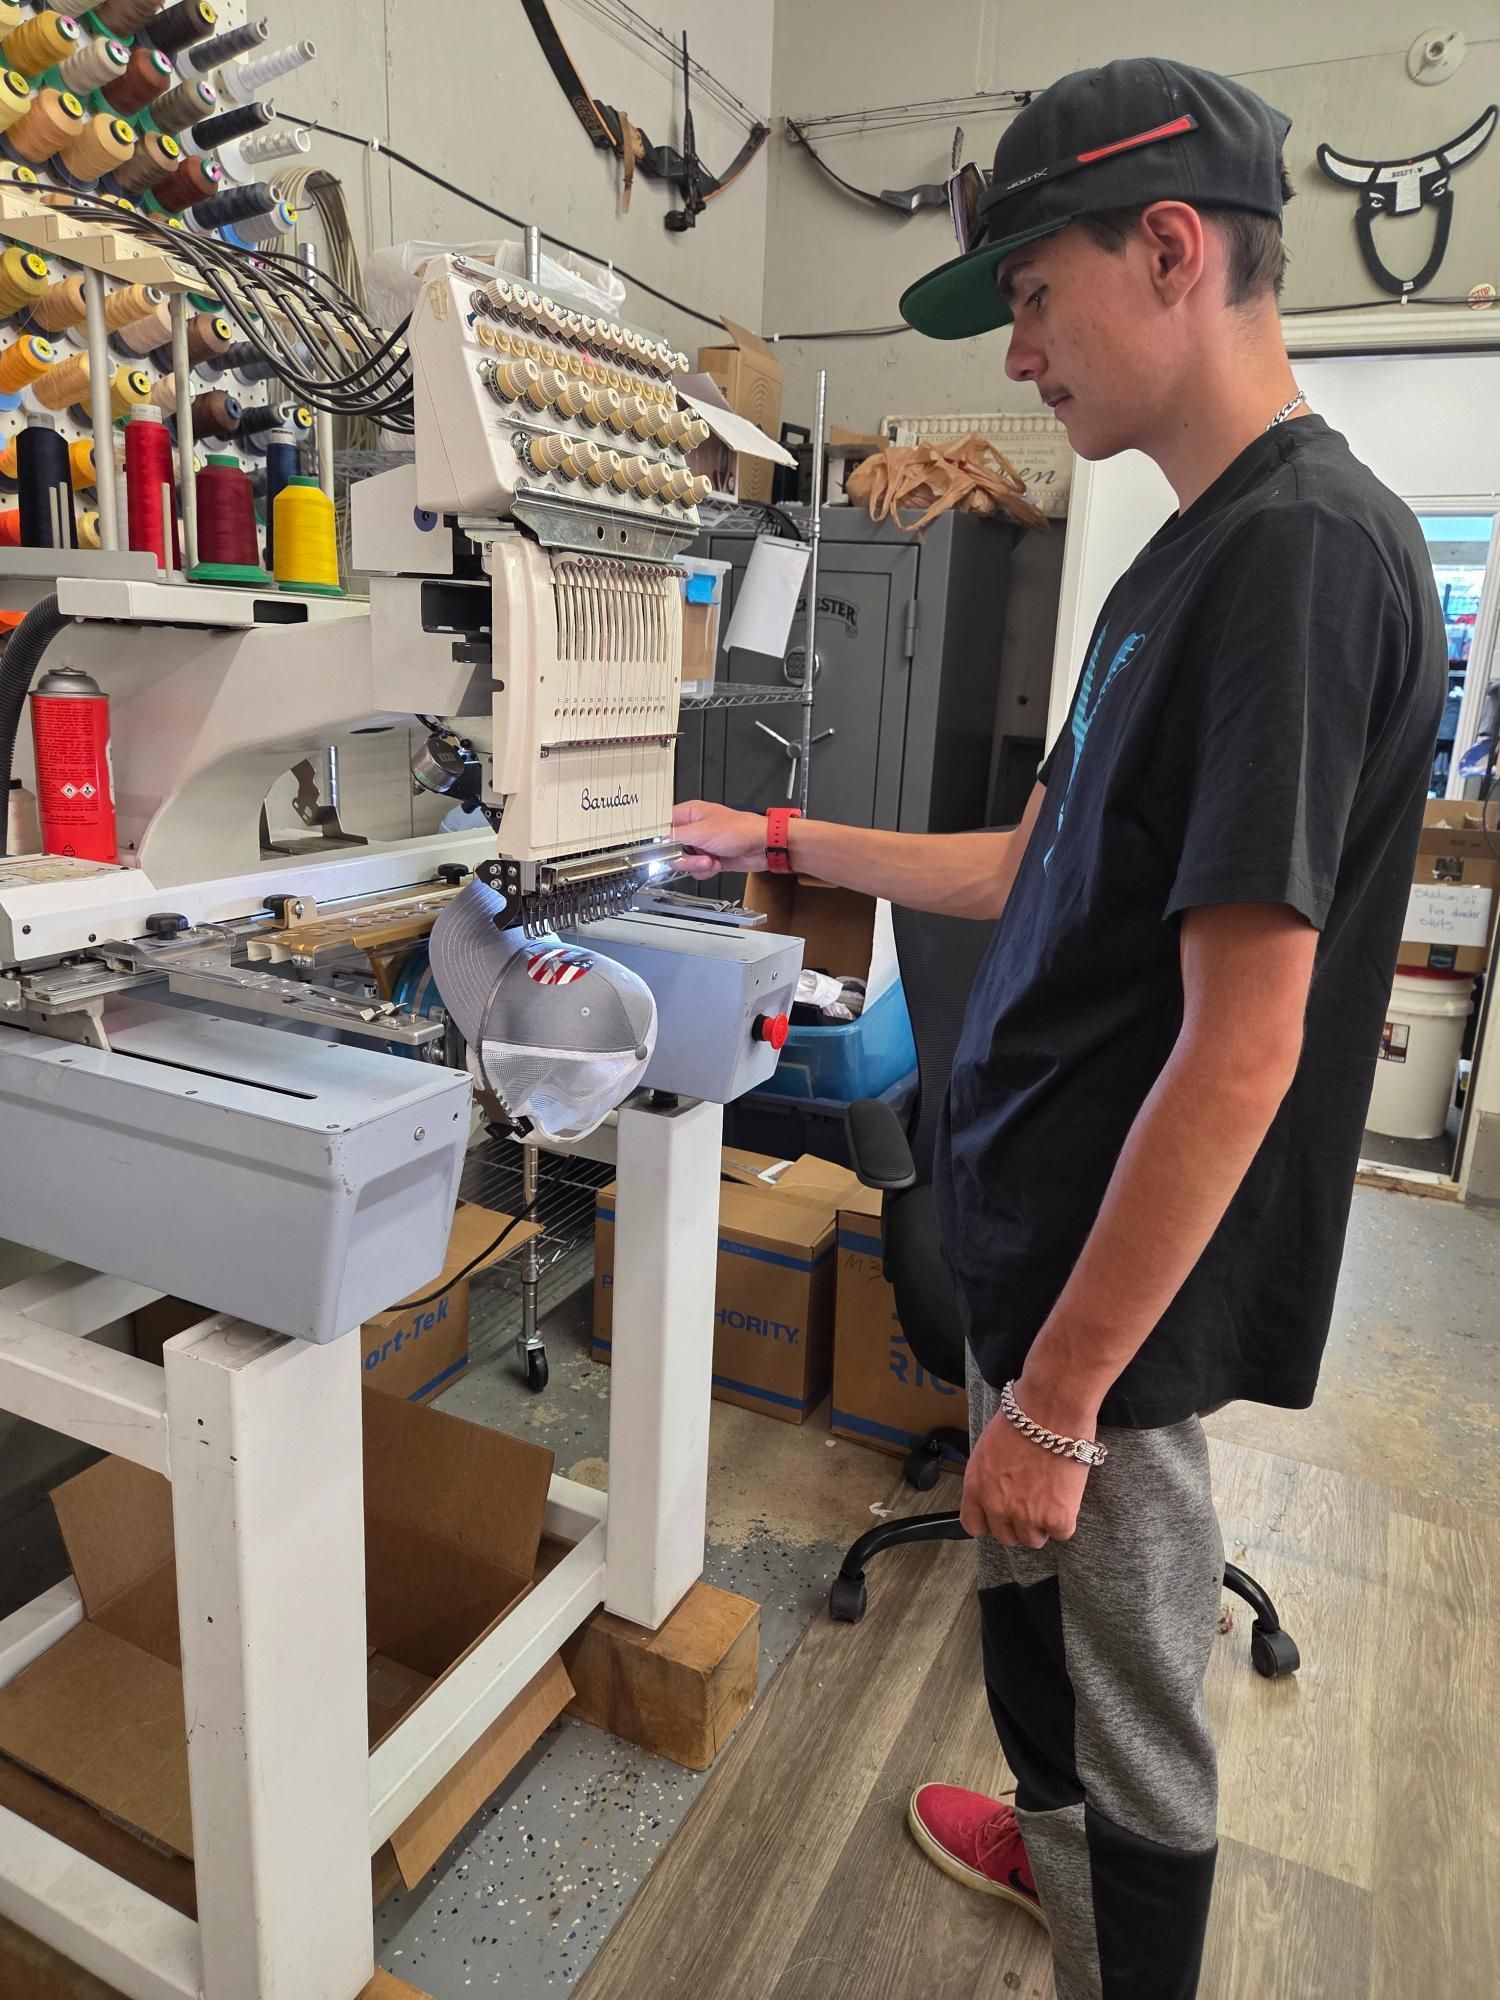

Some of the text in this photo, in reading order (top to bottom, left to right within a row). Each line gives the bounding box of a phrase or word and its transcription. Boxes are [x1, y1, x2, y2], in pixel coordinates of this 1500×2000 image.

[795, 597, 857, 626] CSTER
[580, 784, 639, 811] Barudan
[365, 1296, 449, 1371] ort-Tek
